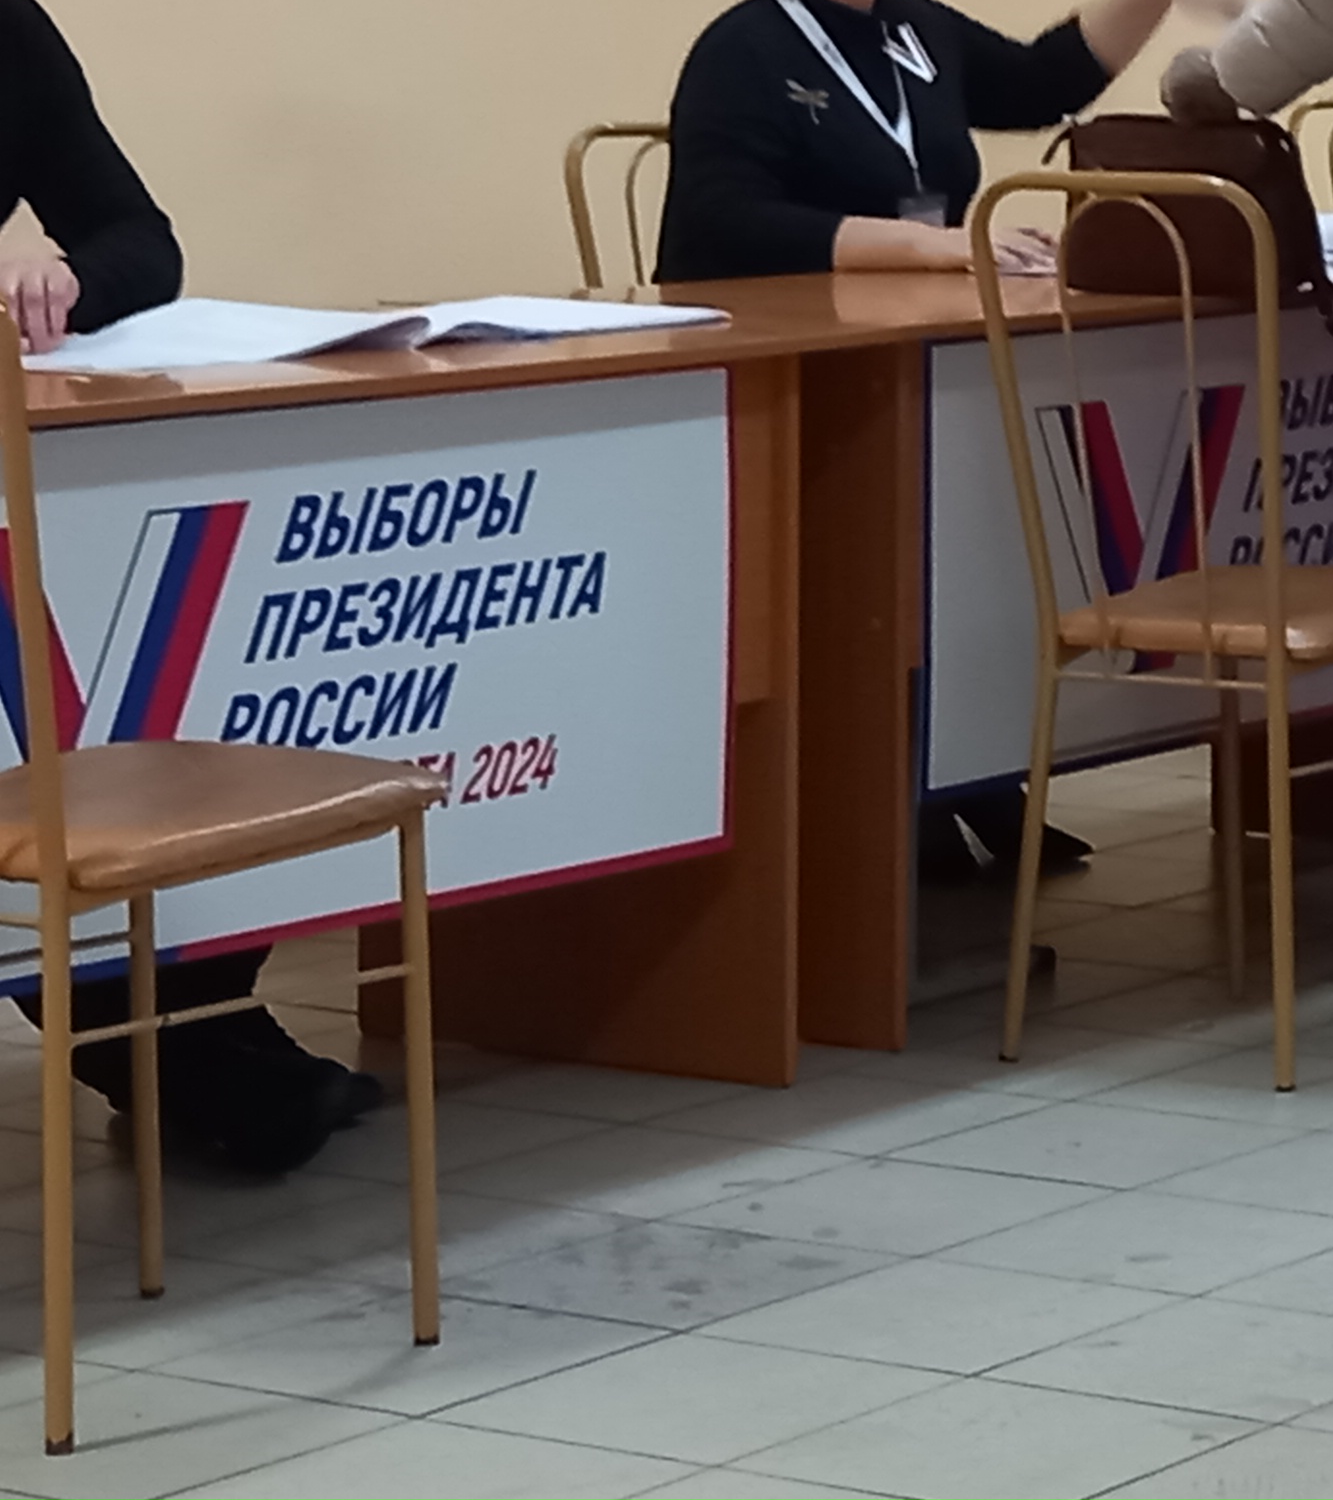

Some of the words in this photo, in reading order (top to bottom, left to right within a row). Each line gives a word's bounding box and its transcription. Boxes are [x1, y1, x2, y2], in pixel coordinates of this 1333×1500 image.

[275, 468, 538, 564] ВЫБОРЫ
[243, 550, 607, 664] ПРЕЗИДЕНТА
[220, 662, 459, 748] РОССИИ
[459, 732, 558, 804] 2024
